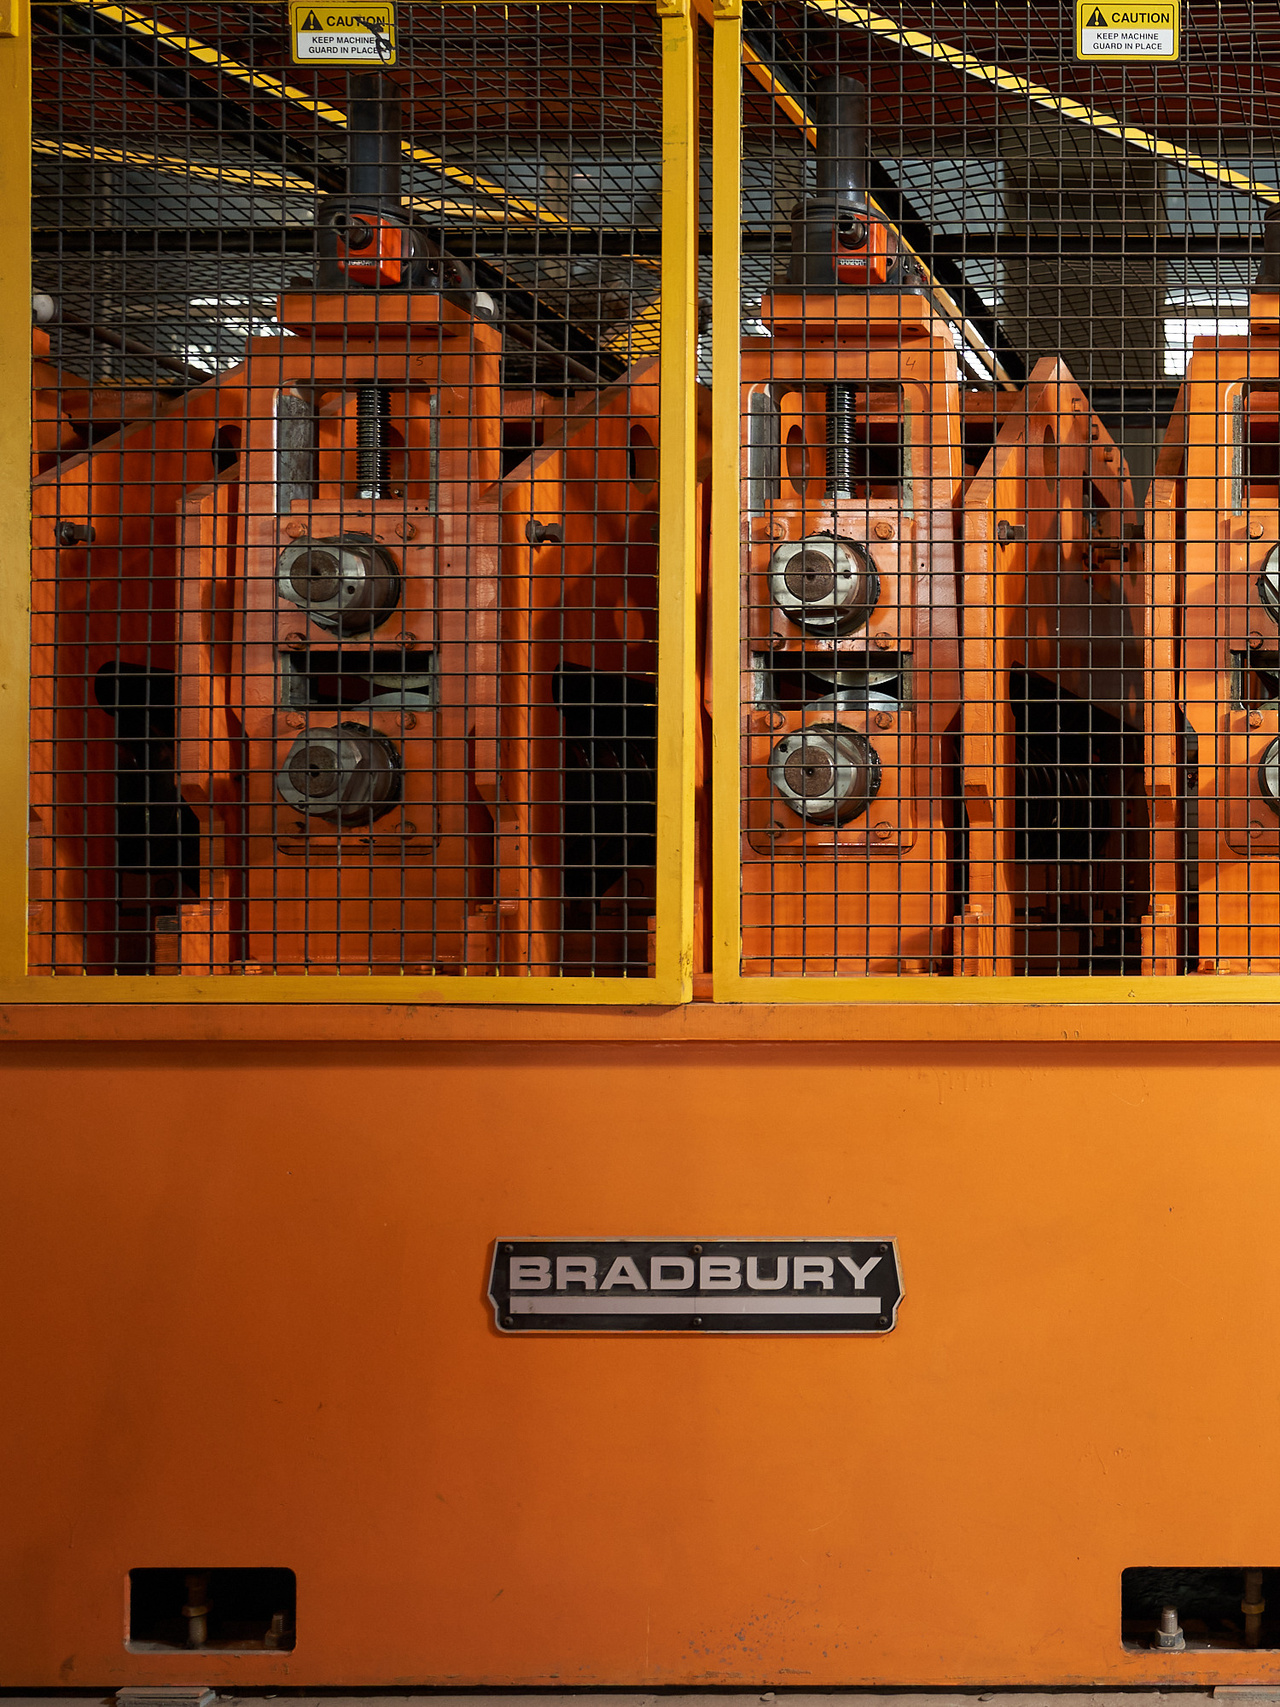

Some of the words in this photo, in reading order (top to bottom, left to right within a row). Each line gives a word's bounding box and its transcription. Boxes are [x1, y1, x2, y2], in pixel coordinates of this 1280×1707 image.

[1111, 12, 1170, 23] CAUTION
[312, 36, 334, 44] KEEP
[336, 36, 374, 44] MACHINE
[308, 46, 338, 54] GUARD
[340, 46, 348, 54] IN
[351, 46, 378, 54] PLACE
[906, 356, 916, 371] 4
[509, 1256, 883, 1290] BRADBURY
